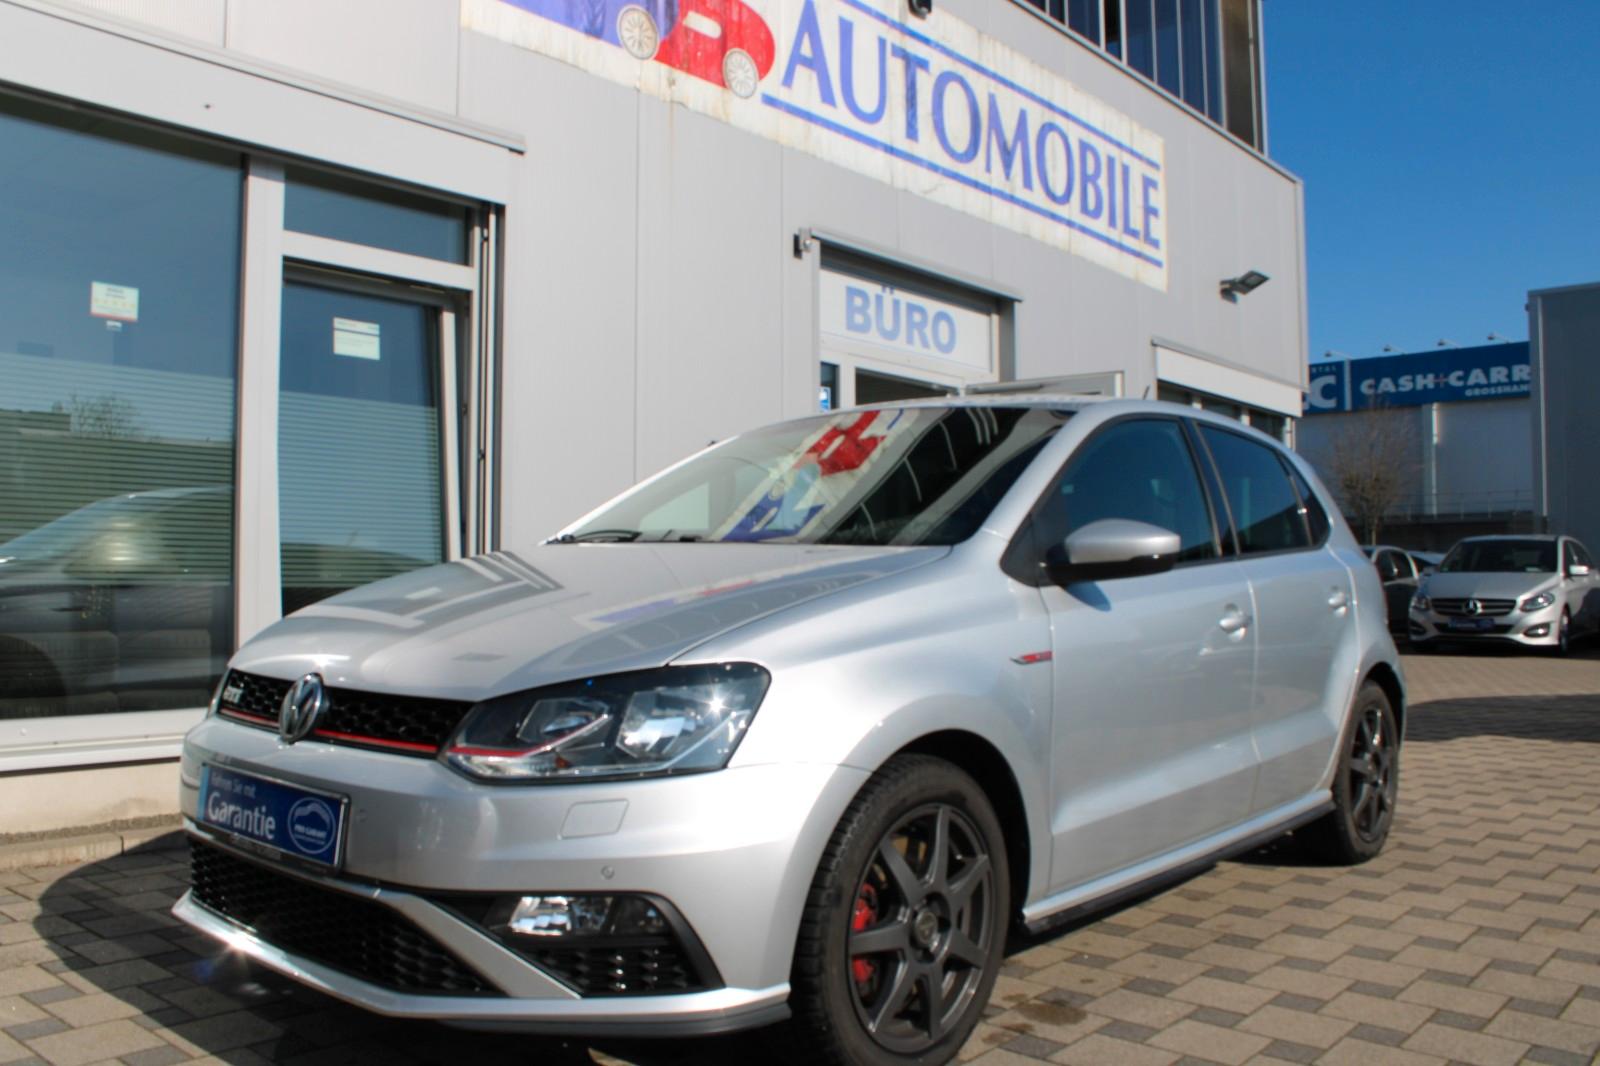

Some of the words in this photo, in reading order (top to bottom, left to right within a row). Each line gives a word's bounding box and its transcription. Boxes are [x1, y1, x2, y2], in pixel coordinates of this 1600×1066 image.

[782, 0, 1161, 250] AUTOMOBILE
[845, 284, 957, 354] BÜRO
[207, 791, 276, 840] Garantie
